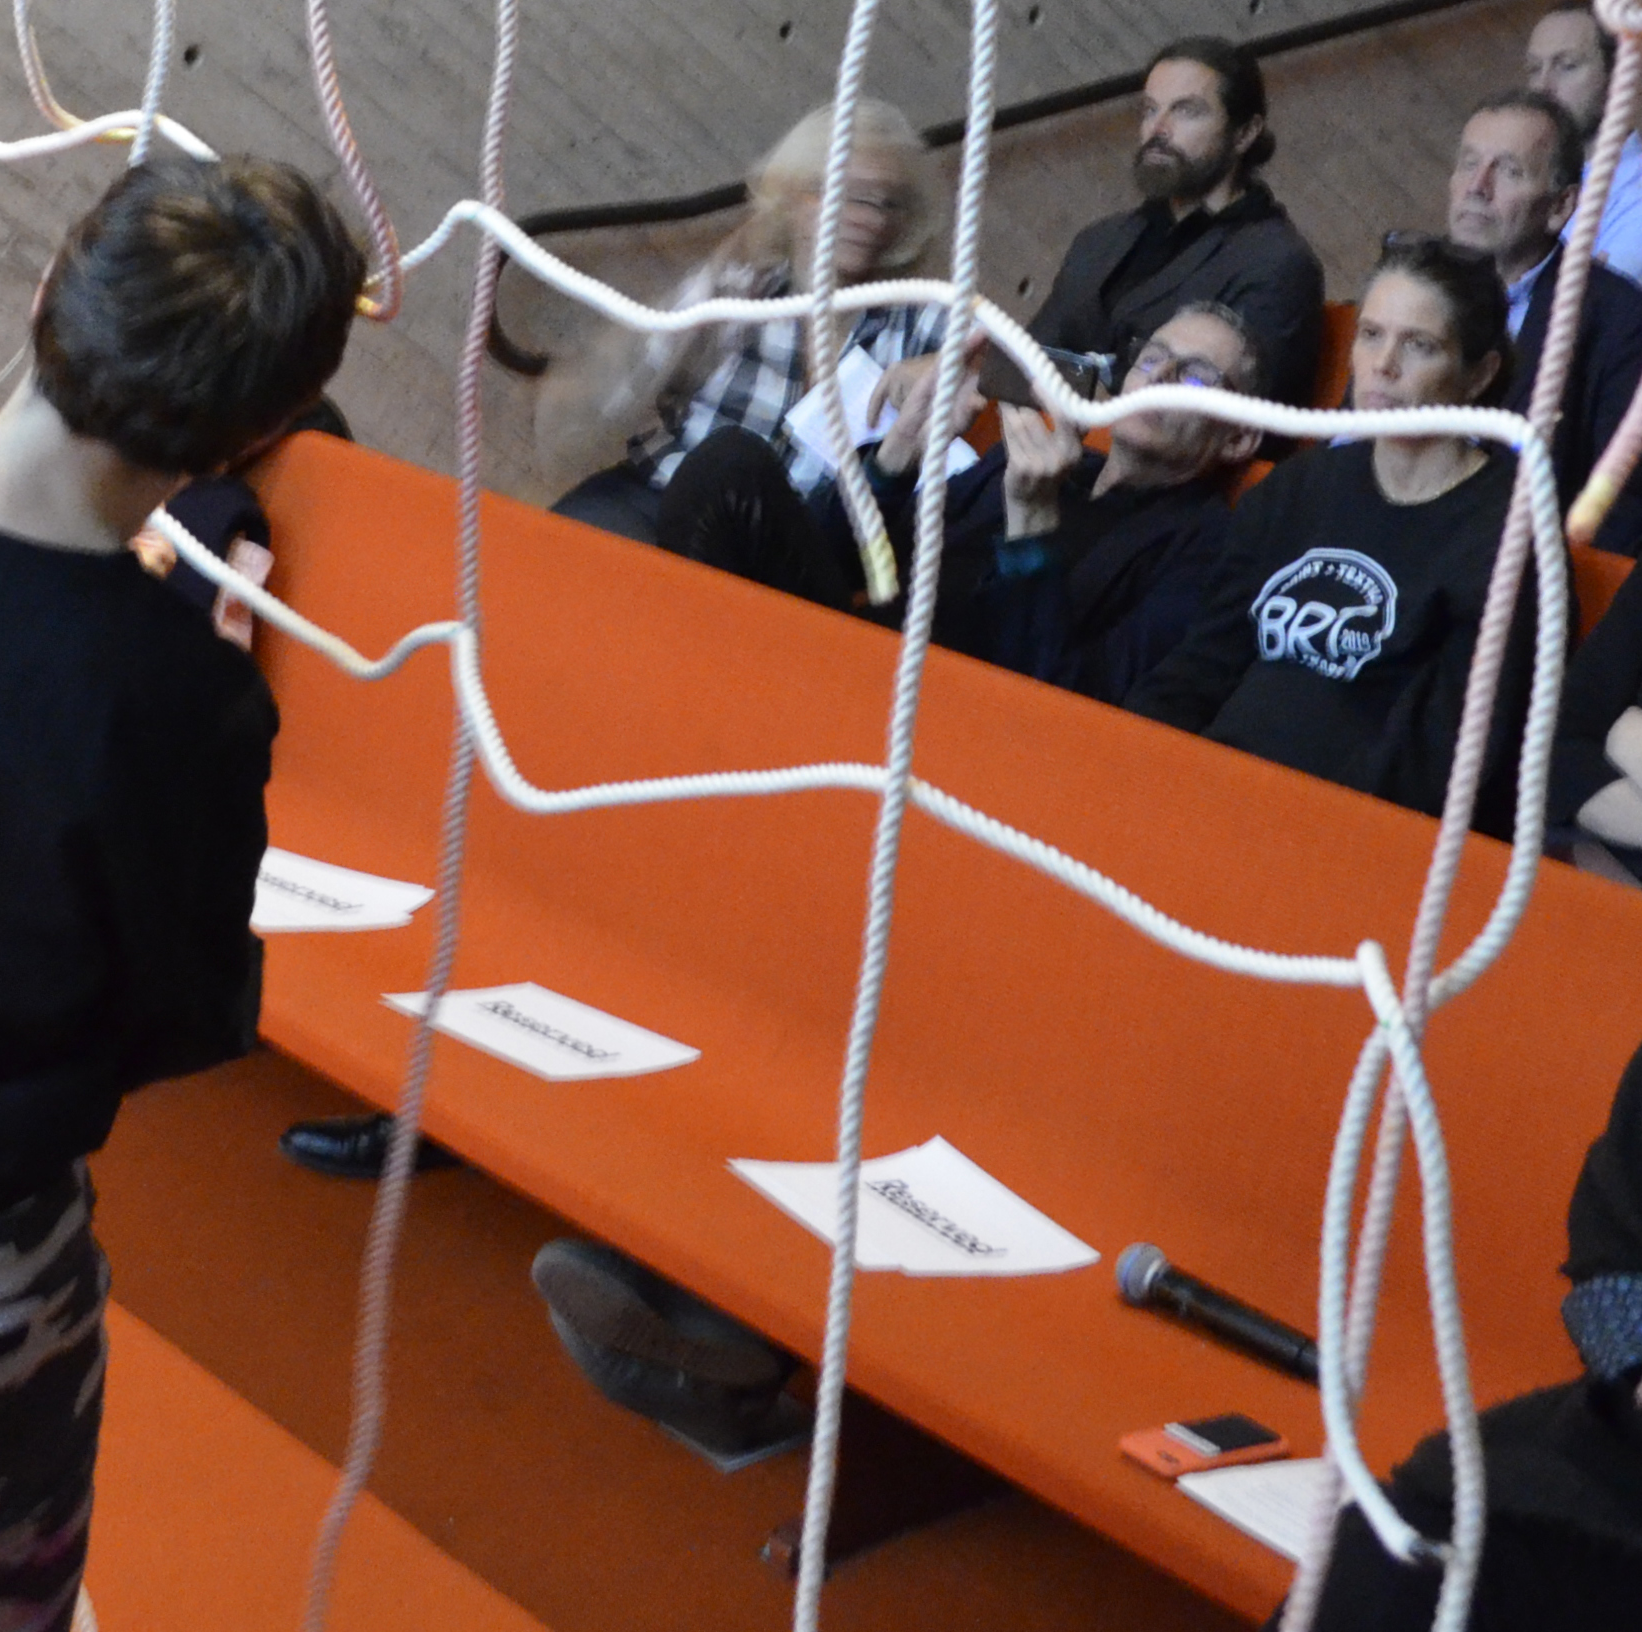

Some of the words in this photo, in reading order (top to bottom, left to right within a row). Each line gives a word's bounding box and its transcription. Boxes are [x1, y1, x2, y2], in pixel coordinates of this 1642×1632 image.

[1259, 594, 1378, 661] BRC
[476, 1000, 621, 1060] Reserved
[865, 1179, 1009, 1254] Reserved
